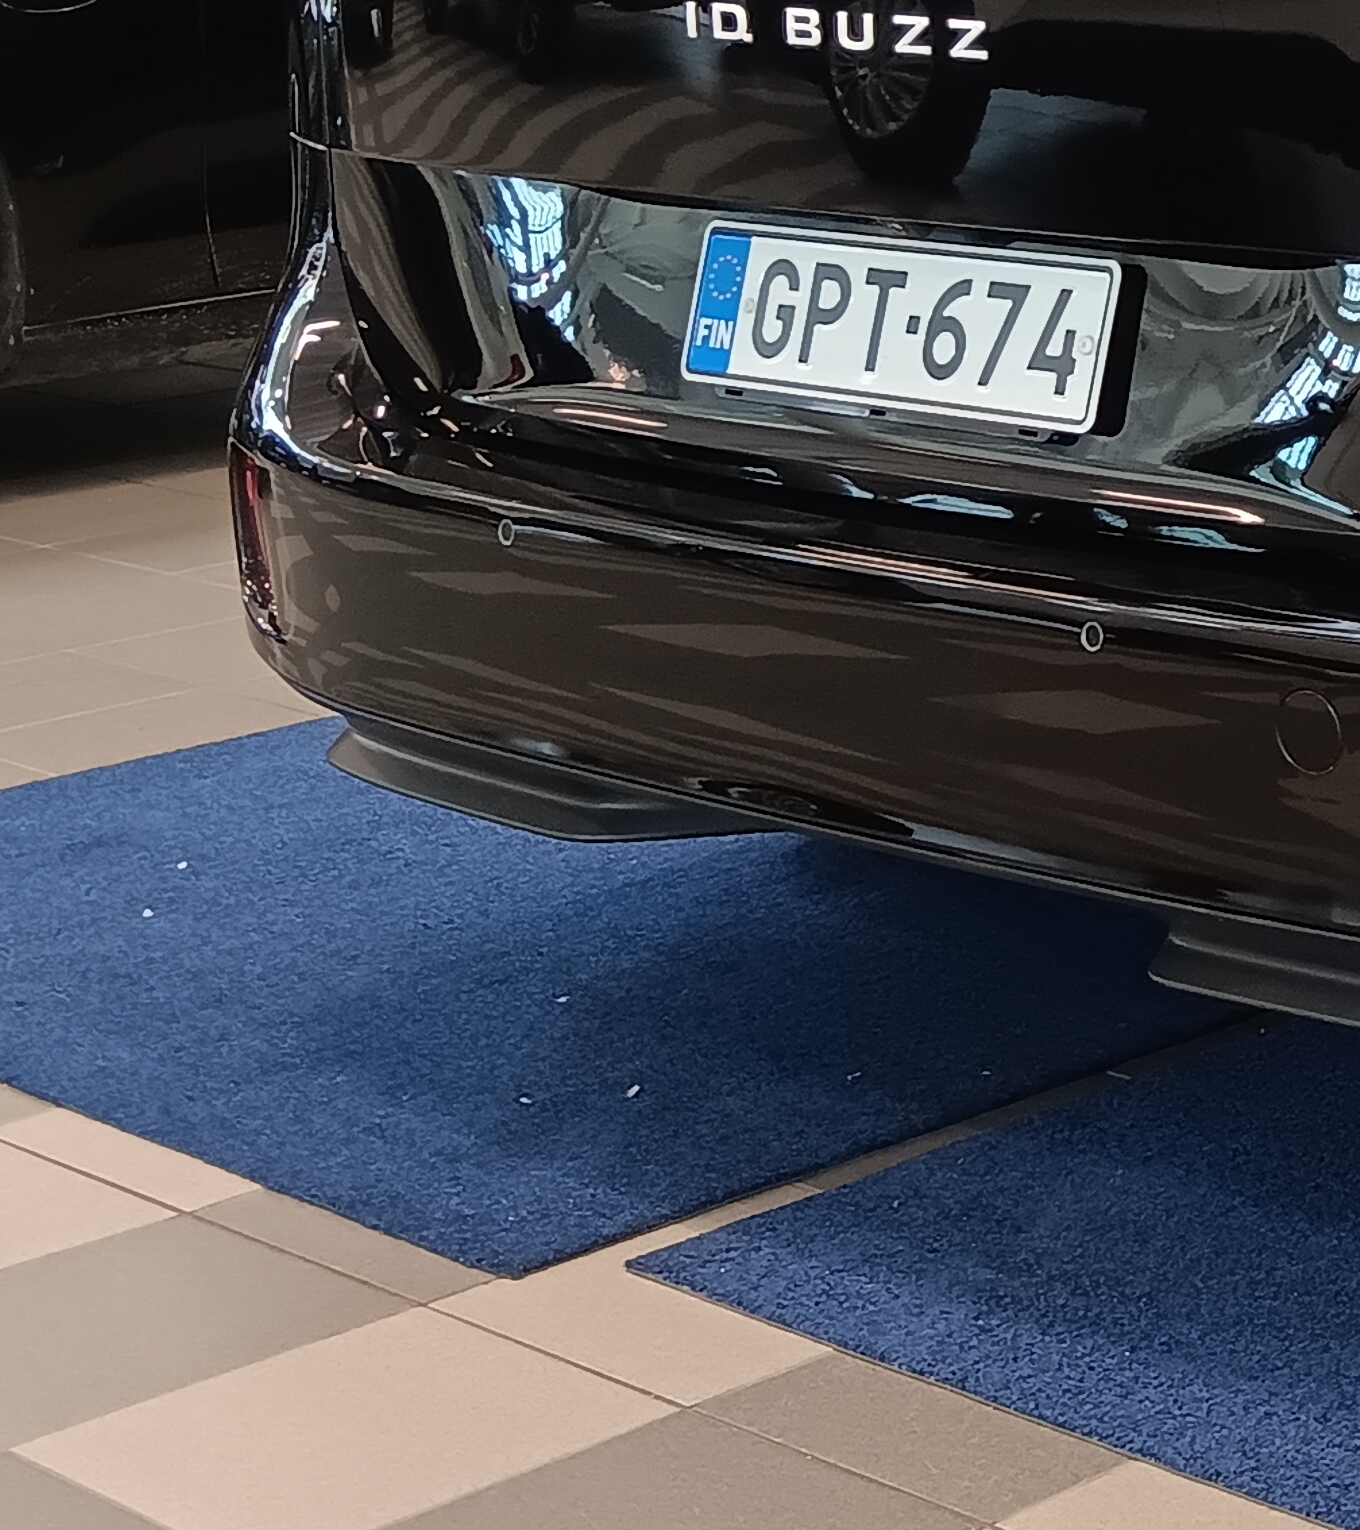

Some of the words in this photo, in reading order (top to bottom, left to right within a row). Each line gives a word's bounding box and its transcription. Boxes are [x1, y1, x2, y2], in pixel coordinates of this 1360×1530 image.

[784, 6, 989, 61] BUZZ
[695, 317, 735, 350] FIN
[751, 257, 1077, 397] GPT-674
